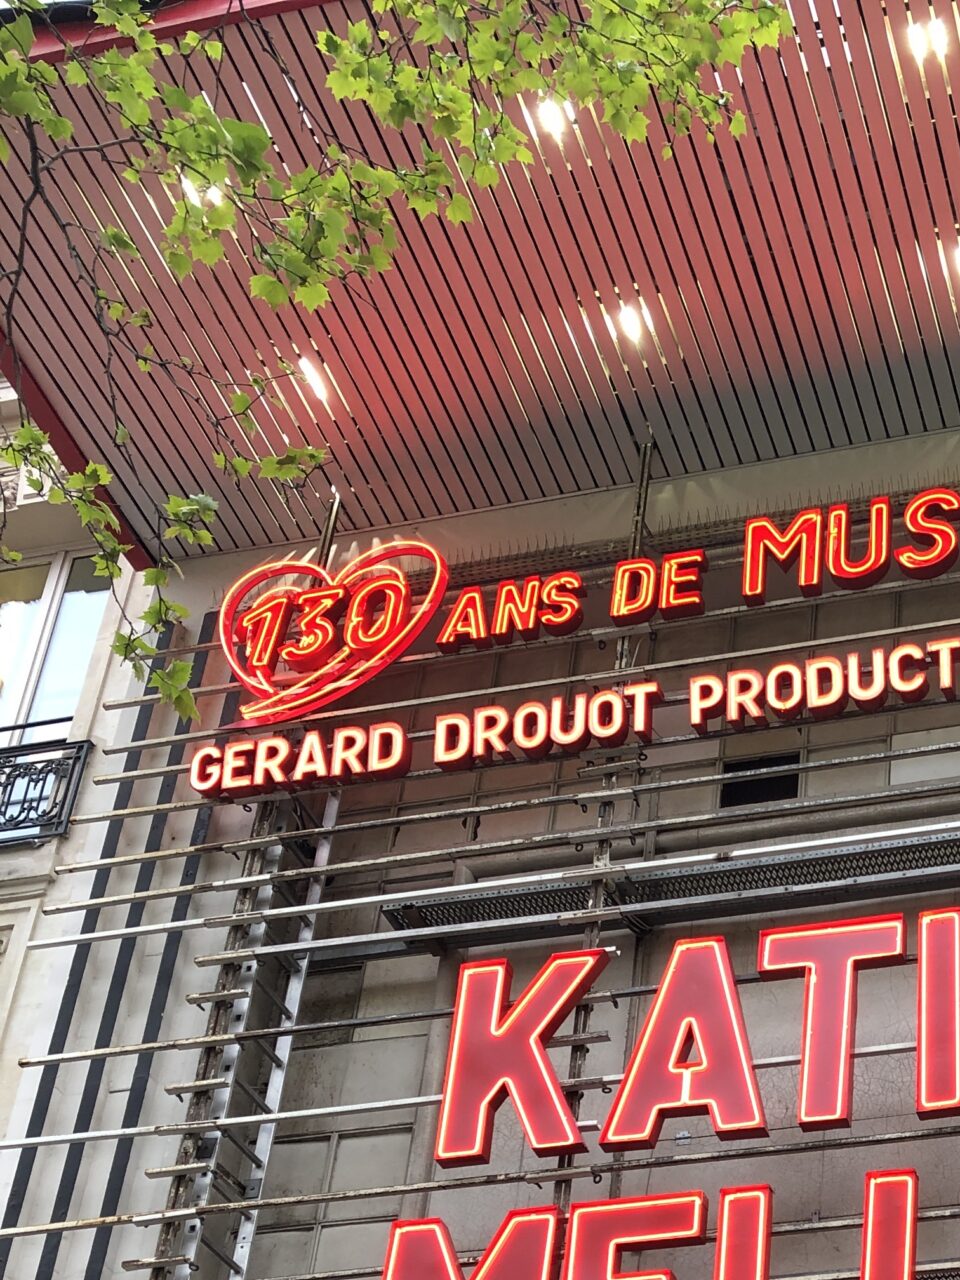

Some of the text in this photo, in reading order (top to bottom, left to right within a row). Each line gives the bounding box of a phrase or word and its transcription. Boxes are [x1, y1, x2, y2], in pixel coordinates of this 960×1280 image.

[238, 574, 411, 674] 130
[437, 572, 585, 653] ANS
[611, 548, 706, 625] DE
[189, 720, 412, 798] GERARD
[434, 683, 661, 770] DROUOT
